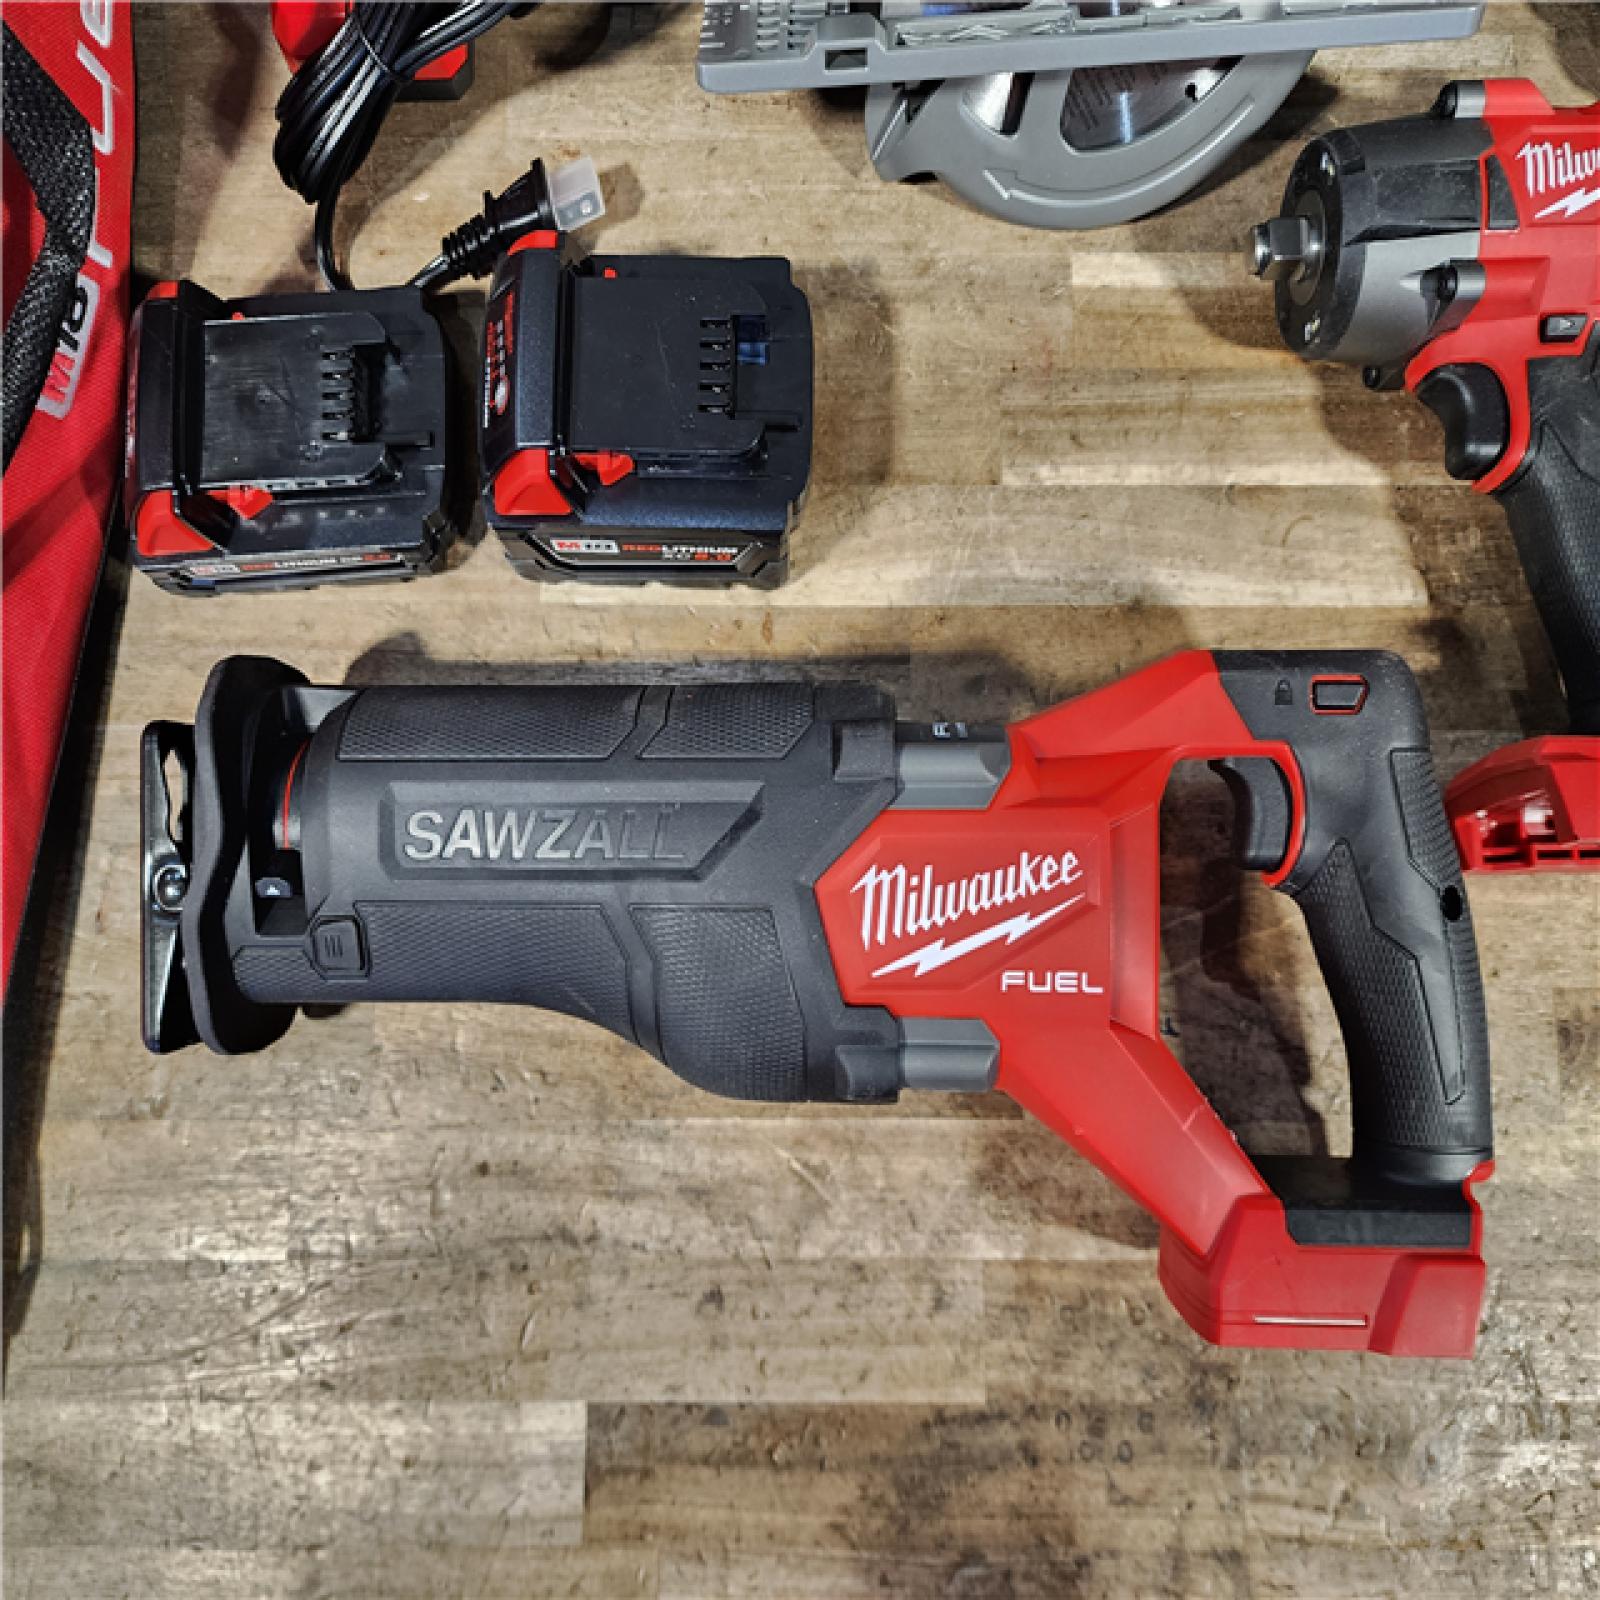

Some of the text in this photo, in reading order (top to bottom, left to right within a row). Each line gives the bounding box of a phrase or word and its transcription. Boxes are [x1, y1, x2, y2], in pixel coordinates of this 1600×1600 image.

[1515, 142, 1600, 198] Milw
[404, 806, 685, 860] SAWZALL
[850, 851, 1083, 951] Milwaukee
[1001, 970, 1104, 993] FUEL
